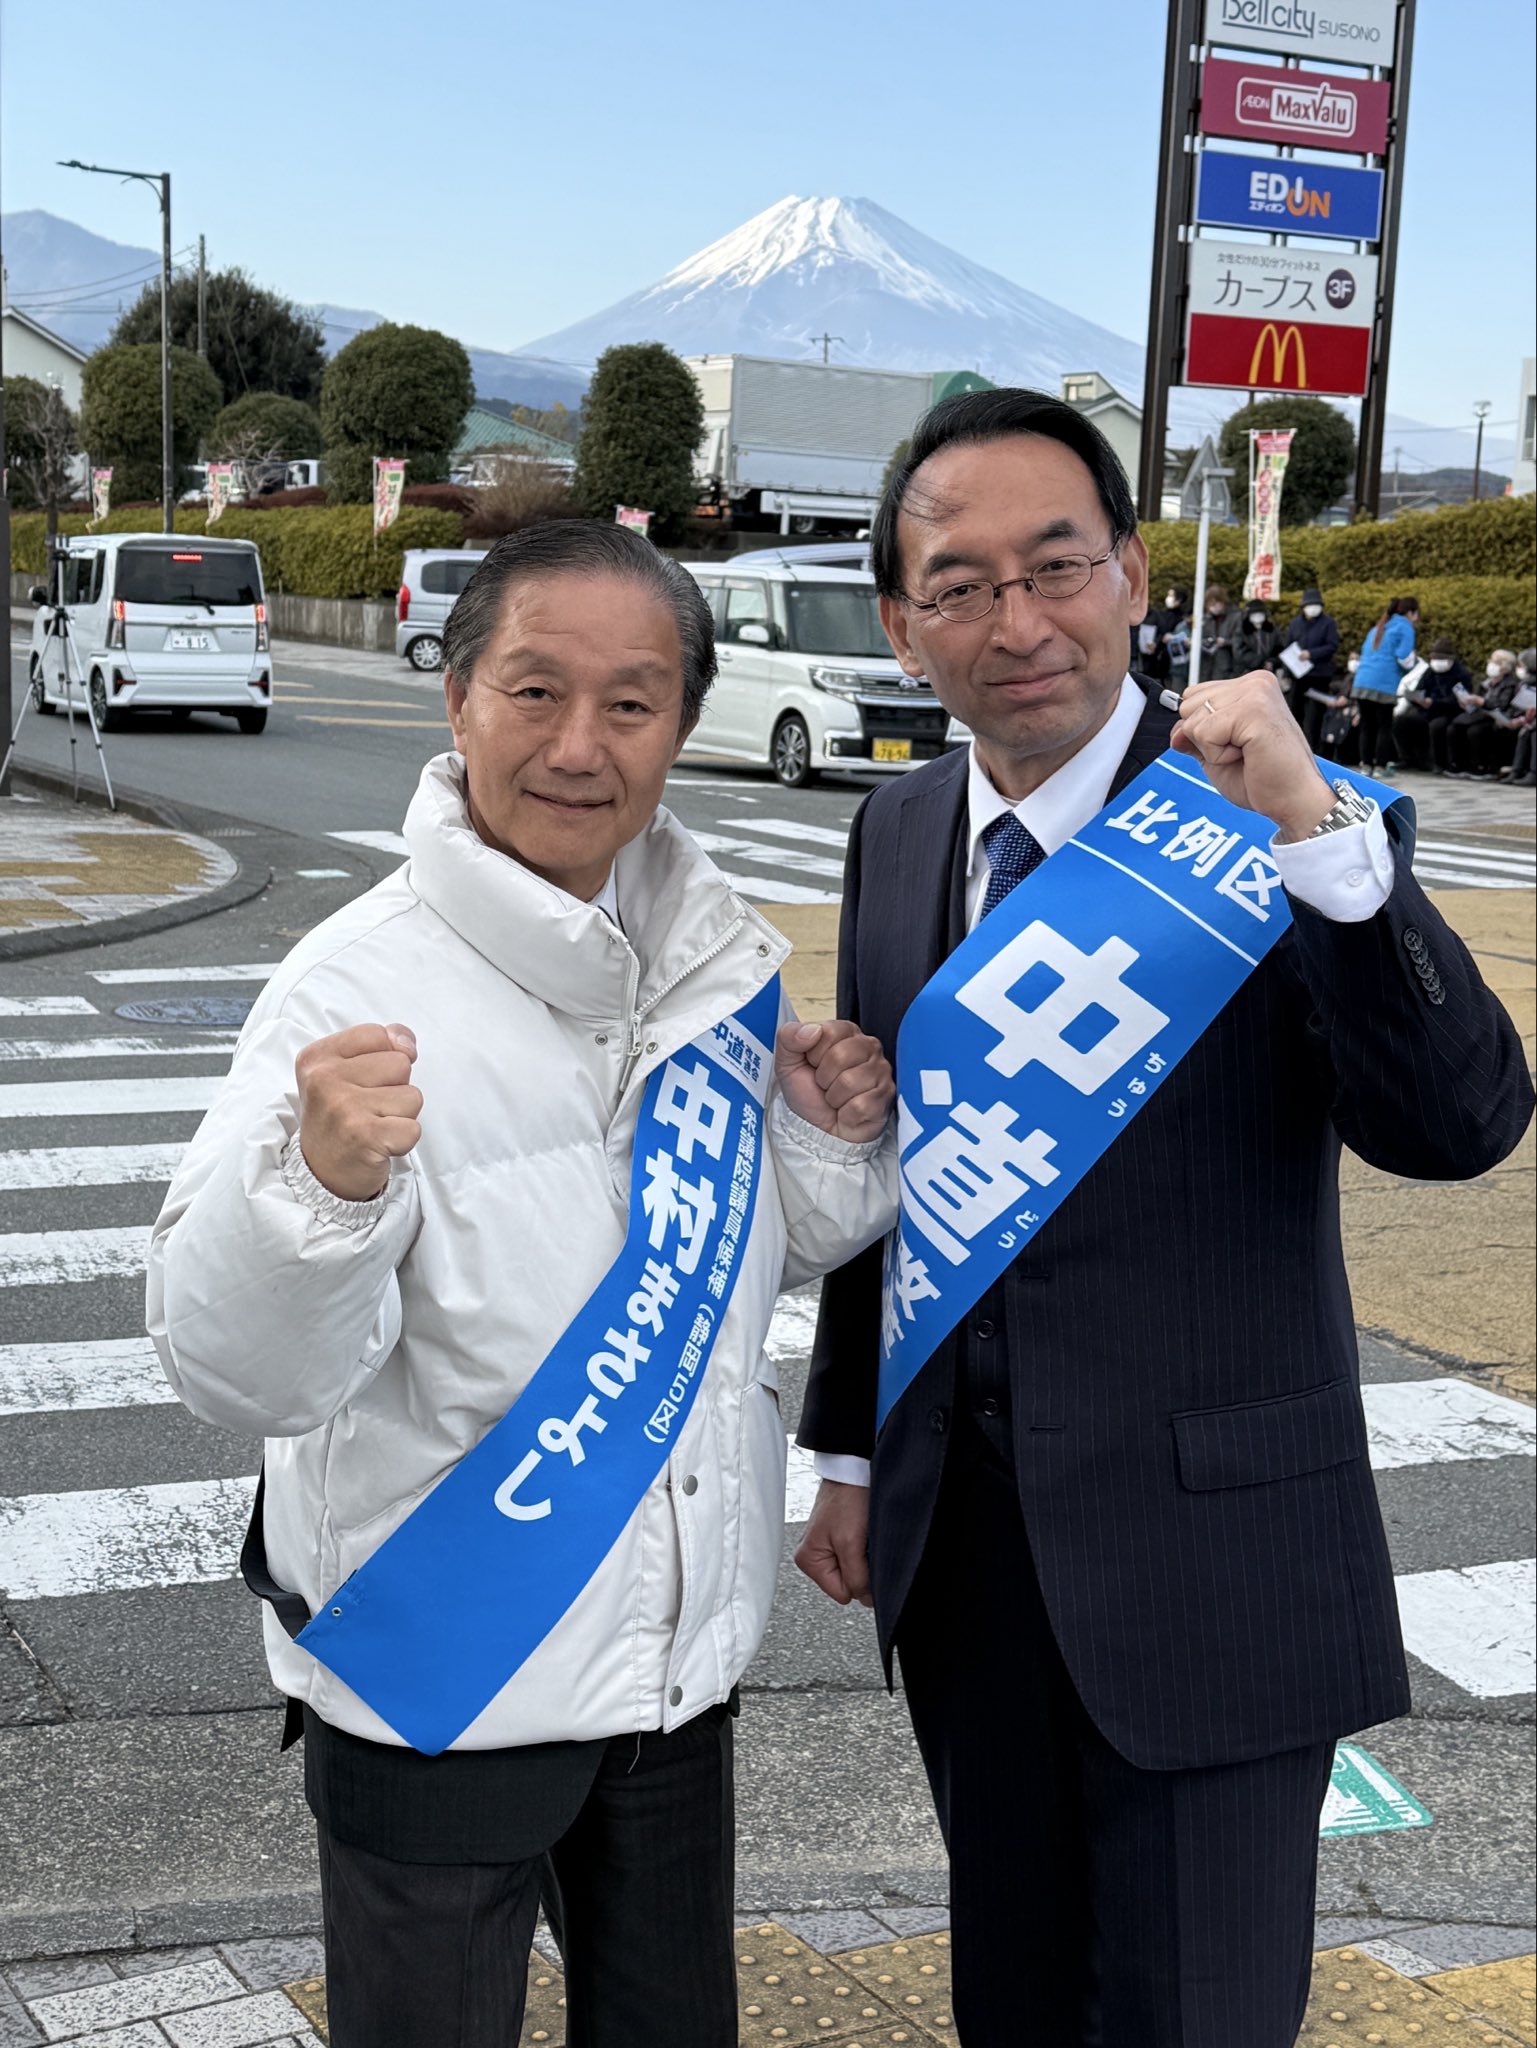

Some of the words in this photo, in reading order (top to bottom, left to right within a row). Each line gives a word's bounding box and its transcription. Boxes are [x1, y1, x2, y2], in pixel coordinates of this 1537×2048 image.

[1318, 20, 1381, 43] SUSONO
[1275, 85, 1347, 125] MaxValu
[1250, 171, 1331, 219] EDION
[1213, 269, 1317, 312] カーブス
[1328, 278, 1353, 300] 3F
[1105, 789, 1283, 923] 比例区
[1107, 1051, 1168, 1119] ちゅう
[998, 1210, 1040, 1250] どう
[494, 1058, 732, 1522] 中村まさよし
